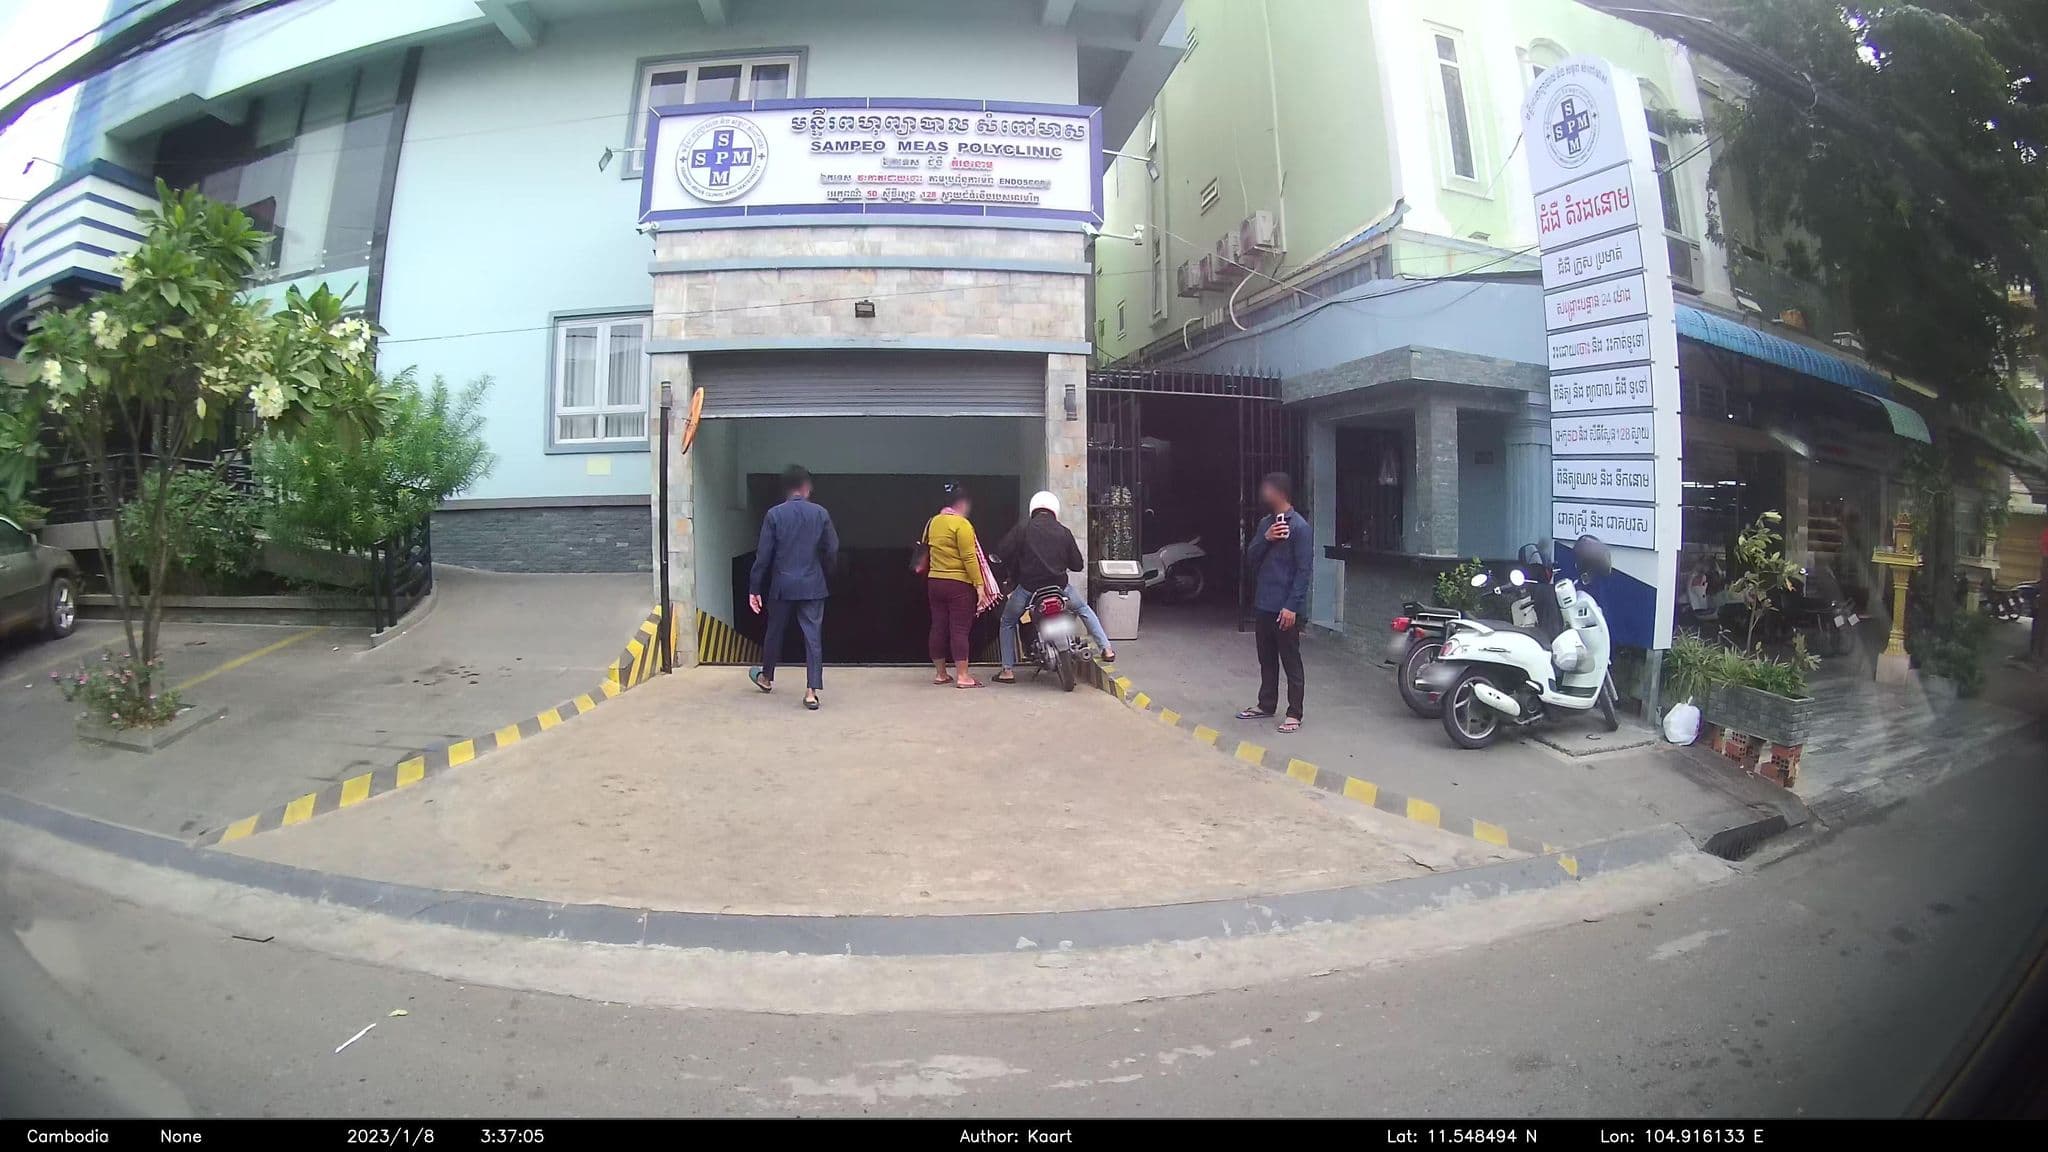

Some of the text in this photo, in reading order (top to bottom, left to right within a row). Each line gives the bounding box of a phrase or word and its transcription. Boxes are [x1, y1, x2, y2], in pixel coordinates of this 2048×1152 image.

[1564, 102, 1573, 117] S
[977, 112, 1085, 138] សំពៅមាស
[1555, 115, 1590, 139] SPM
[718, 133, 730, 148] S
[811, 140, 1063, 157] SAMPEO MEAS POLYCLINIC
[1568, 137, 1581, 153] M
[694, 150, 750, 168] SPM
[711, 170, 729, 186] M
[921, 190, 937, 198] 128
[1540, 187, 1630, 234] ជំងឺ តំរងនោម
[1557, 256, 1571, 275] ជំងឺ
[1592, 336, 1603, 353] និង
[1573, 382, 1584, 399] និង
[1586, 383, 1613, 403] ព្យាបាល
[1615, 375, 1627, 396] ជំងឺ
[1600, 468, 1613, 487] និង
[1616, 468, 1649, 488] ទឹកនោម
[1590, 510, 1604, 529] និង
